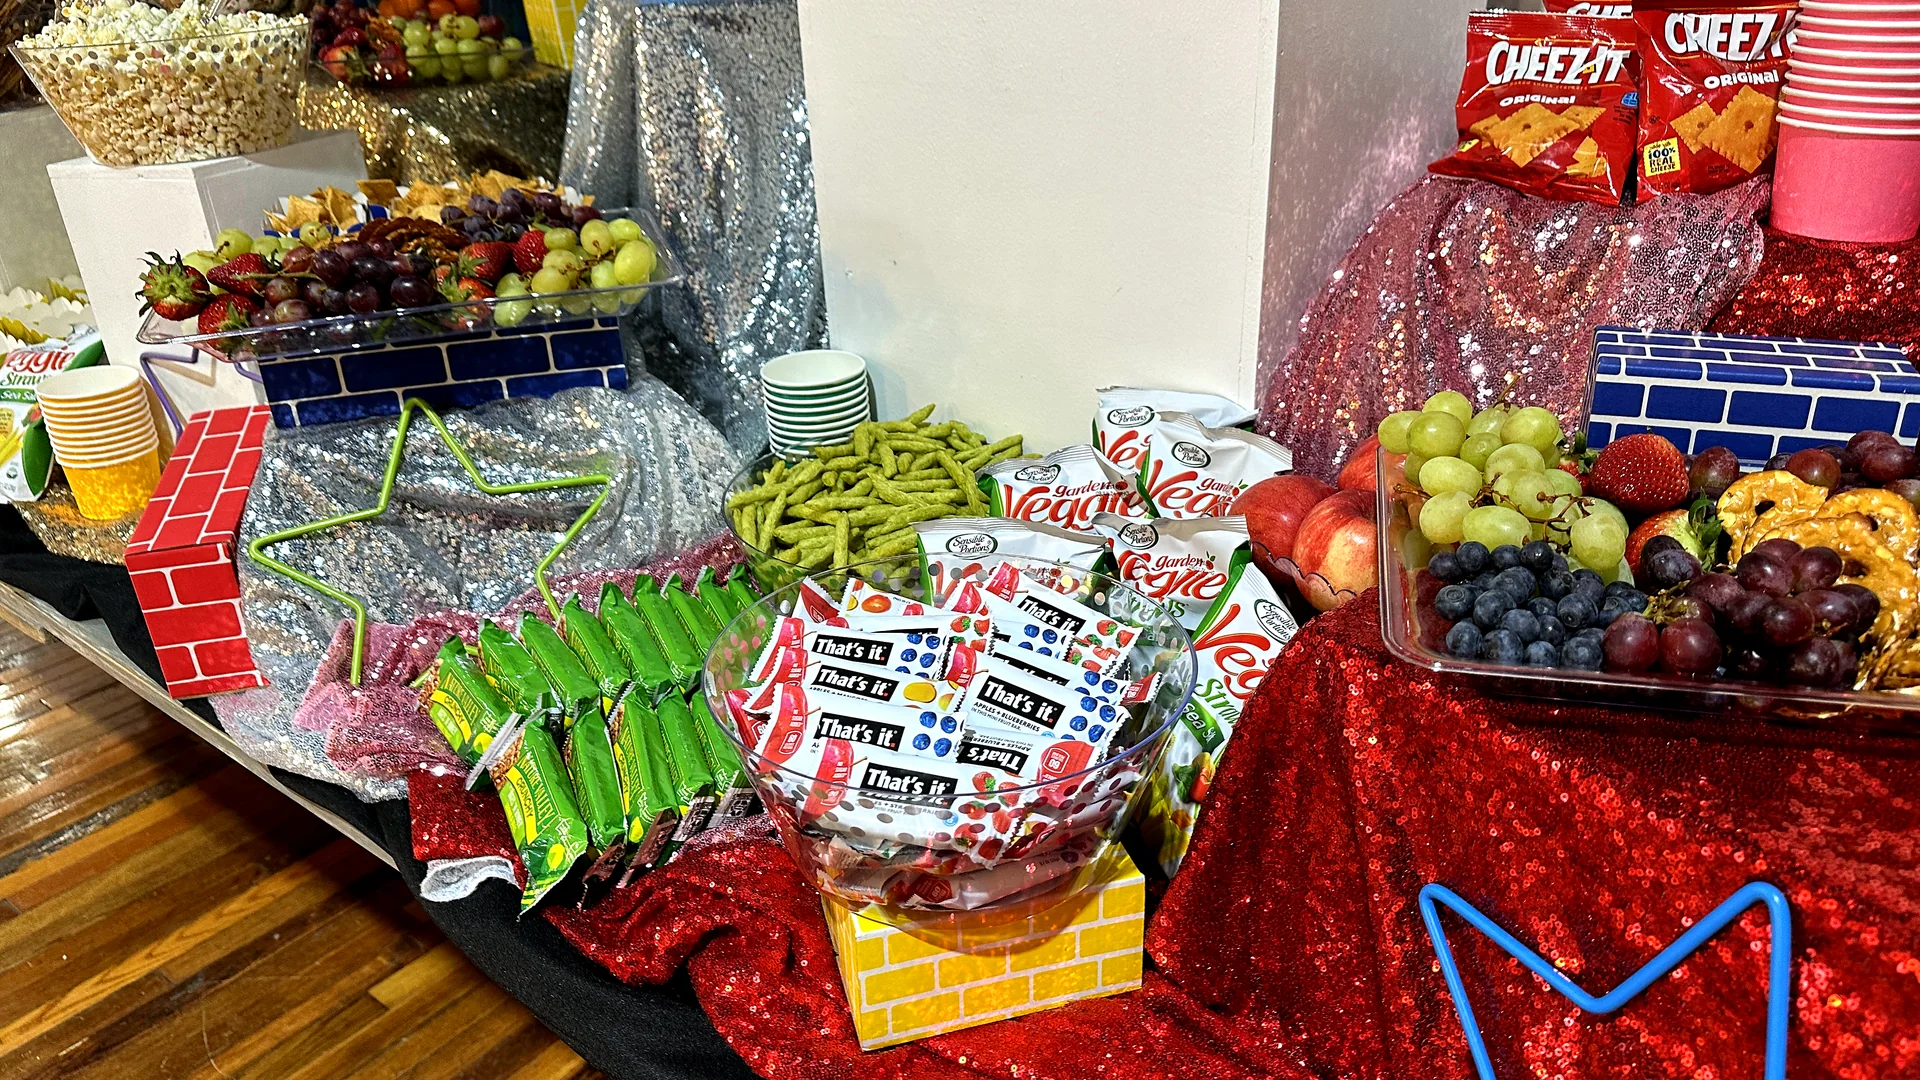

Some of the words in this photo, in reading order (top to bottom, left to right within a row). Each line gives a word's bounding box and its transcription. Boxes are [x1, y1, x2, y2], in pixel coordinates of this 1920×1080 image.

[1648, 147, 1676, 160] 100%
[1649, 155, 1674, 168] REAL
[1650, 162, 1676, 174] CHEESE
[953, 534, 985, 547] Sensible
[959, 543, 990, 553] Portions
[1151, 553, 1204, 571] garden
[1021, 598, 1061, 626] That's
[817, 638, 864, 658] That's
[868, 644, 885, 661] it.
[820, 668, 866, 691] That's
[871, 680, 889, 697] it.
[984, 680, 1034, 713] That's
[1036, 701, 1053, 723] it.
[973, 701, 996, 714] APPLES
[1001, 712, 1041, 732] BLUEBERRIES
[997, 717, 1011, 727] FRUIT
[820, 717, 874, 743] That's
[877, 727, 896, 747] it.
[967, 746, 1021, 771] That's
[867, 768, 924, 795] That's
[515, 777, 534, 819] CRUNCHY
[533, 783, 556, 826] VALLEY
